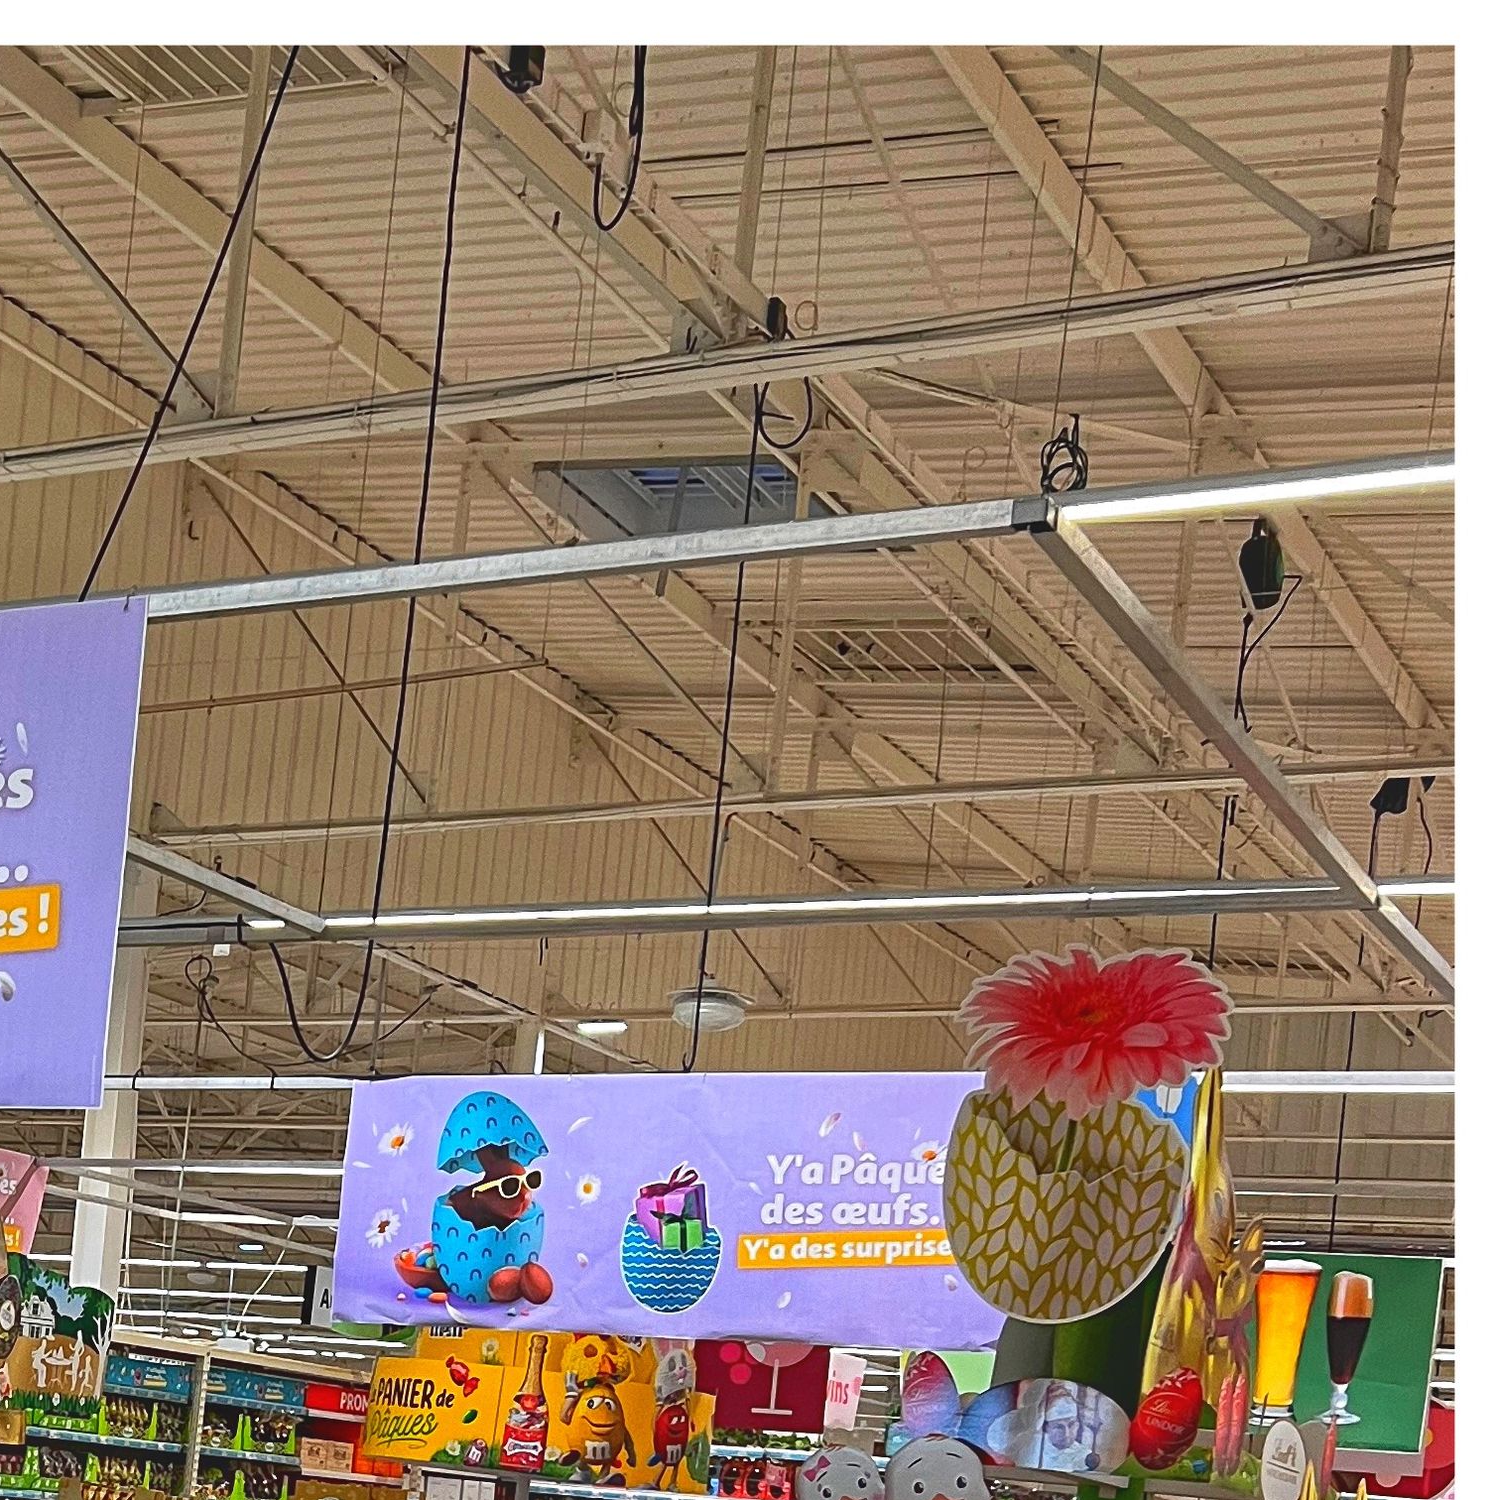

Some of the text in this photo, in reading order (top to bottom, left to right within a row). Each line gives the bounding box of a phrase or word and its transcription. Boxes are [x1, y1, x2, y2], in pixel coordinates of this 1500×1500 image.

[767, 1153, 945, 1193] Y'a Pâque
[761, 1194, 940, 1226] des œufs.
[744, 1233, 951, 1264] Y'a des surprise
[374, 1378, 454, 1409] PANIER de
